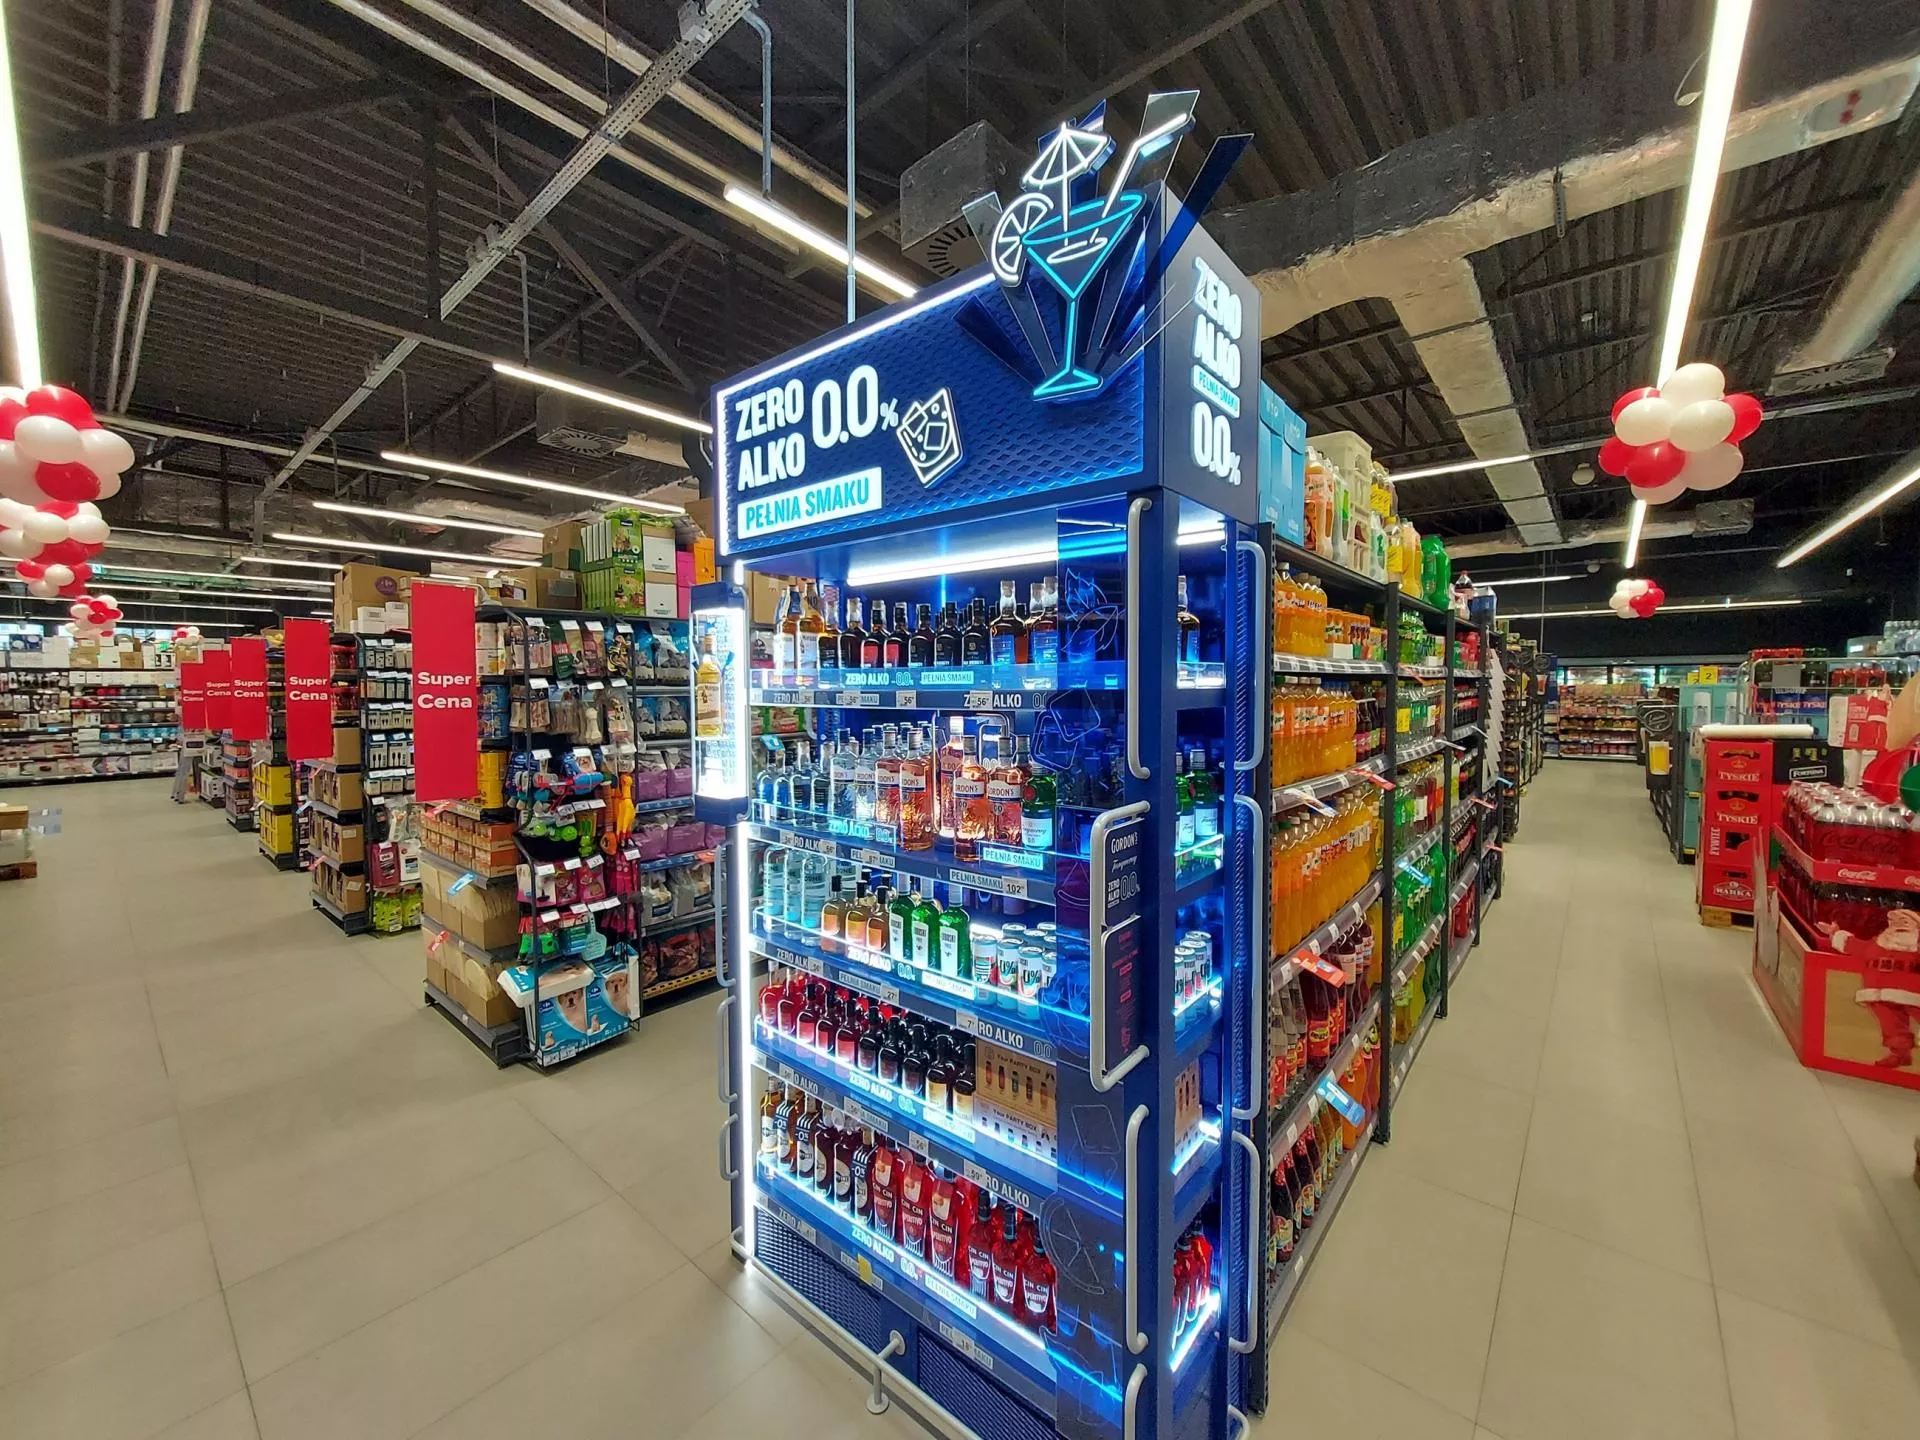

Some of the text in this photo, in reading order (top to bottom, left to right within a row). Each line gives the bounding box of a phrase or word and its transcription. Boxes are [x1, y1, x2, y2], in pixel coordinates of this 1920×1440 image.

[1195, 256, 1242, 340] ZERO
[1194, 314, 1241, 389] ALKO
[735, 379, 805, 442] ZERO
[812, 364, 899, 449] 0.0%
[1194, 402, 1241, 486] 0.0%
[737, 433, 806, 491] ALKO
[745, 477, 869, 531] PEŁNIA SMAKU
[289, 676, 328, 687] Super
[418, 671, 472, 687] Super
[845, 672, 867, 686] ZERO
[867, 672, 889, 686] ALKO
[1706, 672, 1712, 680] 2
[207, 681, 230, 689] Super
[234, 679, 264, 688] Super
[207, 689, 231, 697] Cena
[234, 689, 264, 698] Cena
[289, 690, 328, 701] Cena
[773, 692, 791, 703] ZERO
[418, 693, 473, 709] Cena
[993, 694, 1022, 707] ALKO
[1719, 771, 1760, 782] TYSKIE
[1717, 812, 1758, 825] TYSKIE
[805, 838, 820, 852] ALK
[1111, 831, 1138, 854] GORDON'S
[1108, 878, 1120, 892] ZERO
[1108, 888, 1120, 902] ALKO
[795, 952, 809, 969] ALK
[995, 1028, 1024, 1049] ALKO
[882, 1188, 893, 1199] CIN
[1001, 1183, 1030, 1208] ALKO
[912, 1205, 923, 1216] CIN
[941, 1223, 953, 1234] CIN
[851, 1225, 872, 1248] ZERO
[872, 1240, 895, 1263] ALKO
[979, 1251, 989, 1260] CIN
[1003, 1270, 1014, 1280] CIN
[1036, 1284, 1048, 1293] CIN
